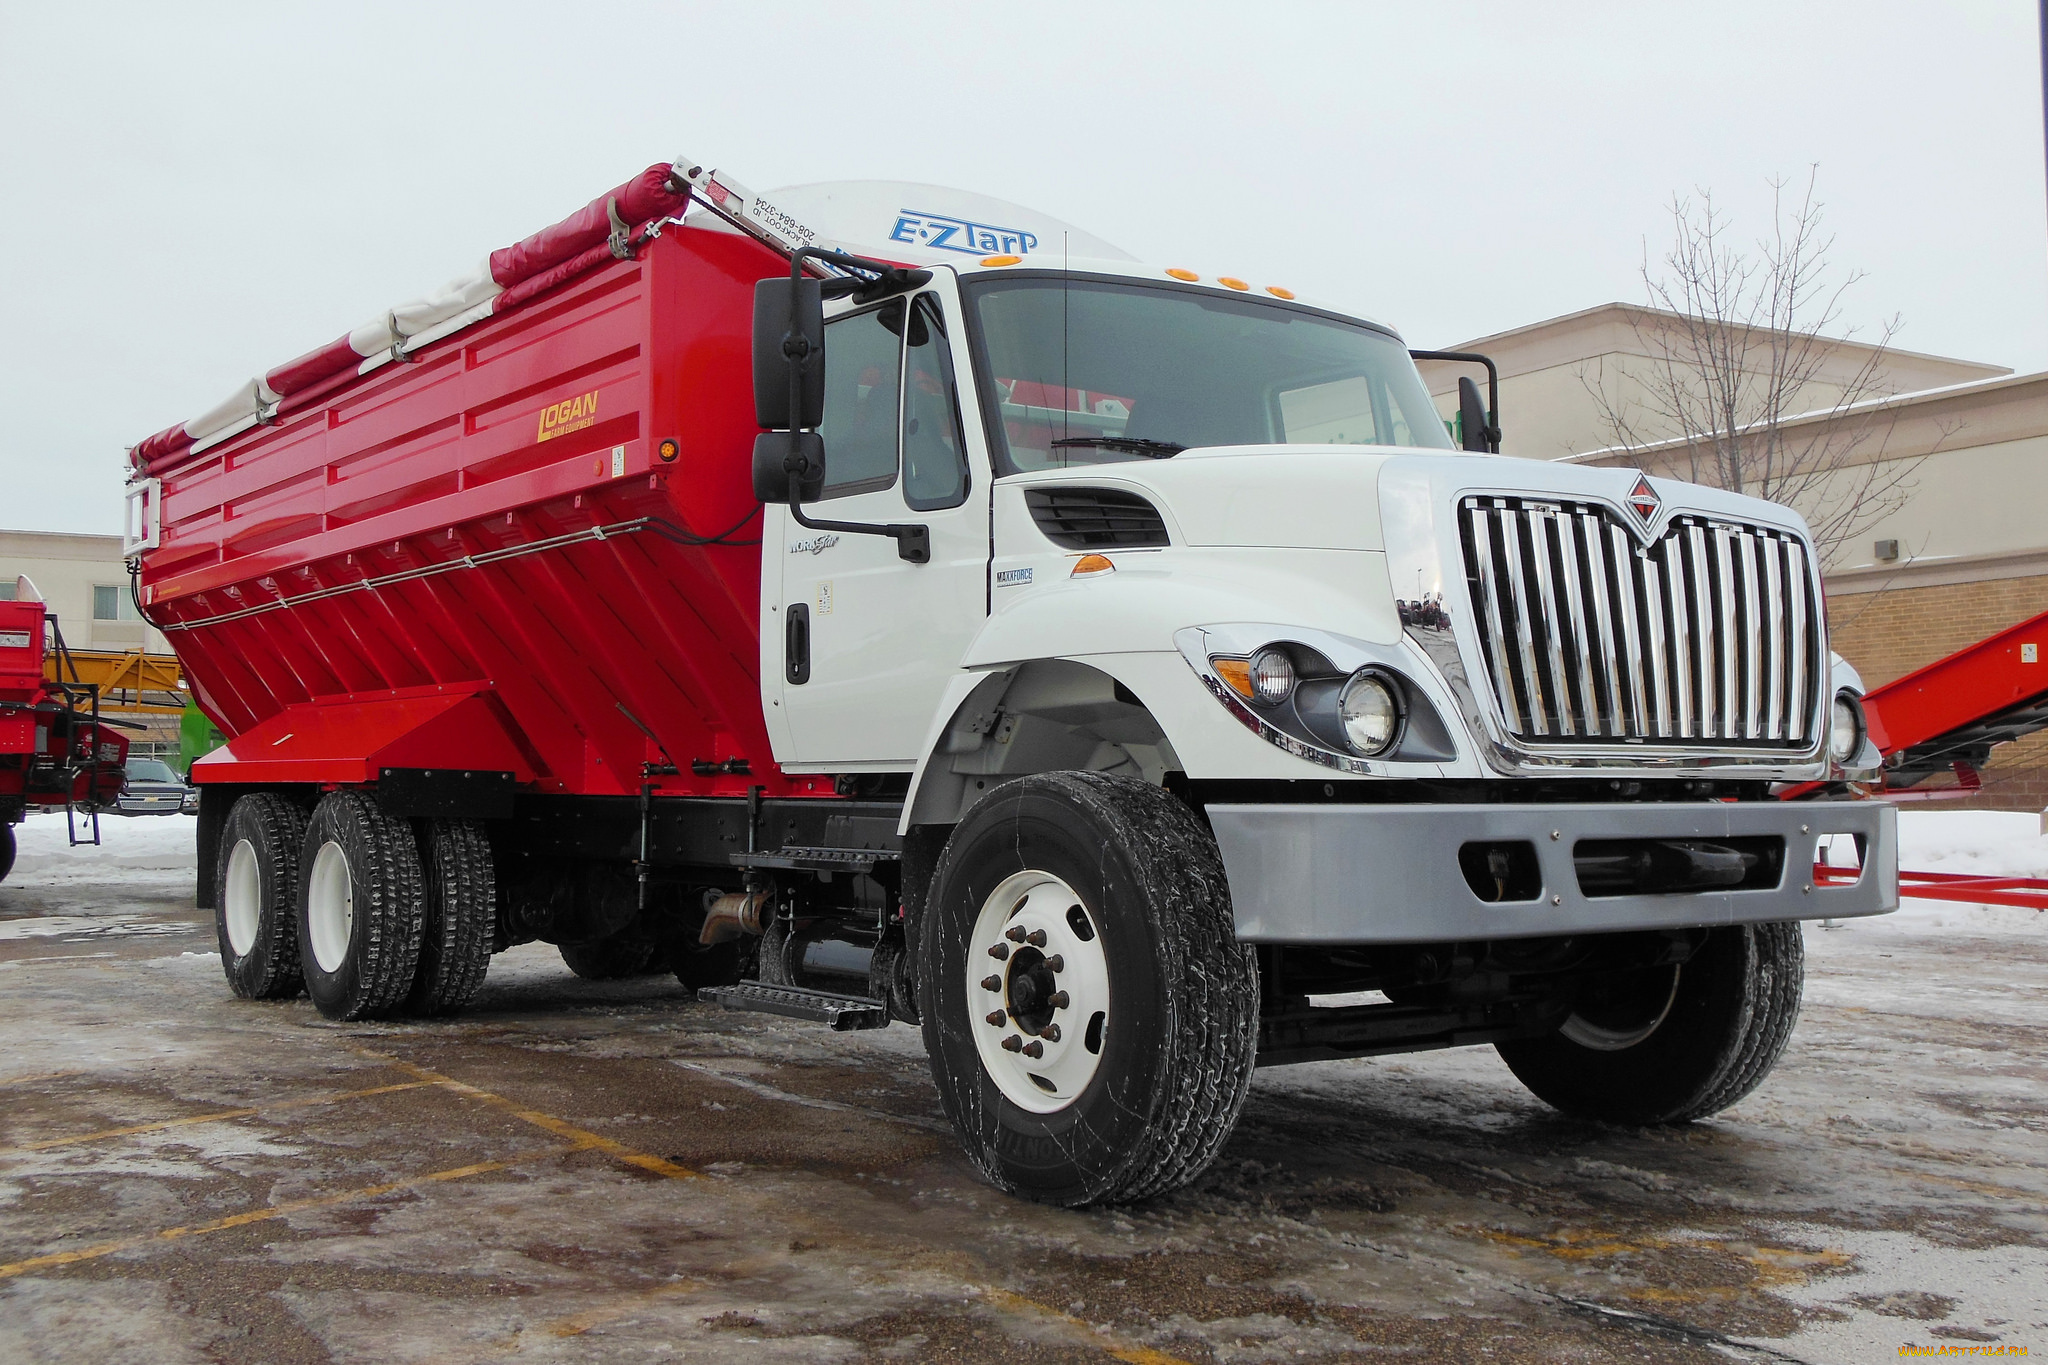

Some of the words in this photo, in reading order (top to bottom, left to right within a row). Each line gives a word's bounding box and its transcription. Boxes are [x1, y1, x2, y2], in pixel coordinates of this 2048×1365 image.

[752, 207, 762, 218] ID
[755, 197, 816, 241] 208-684-3734
[537, 390, 598, 443] LOGAN
